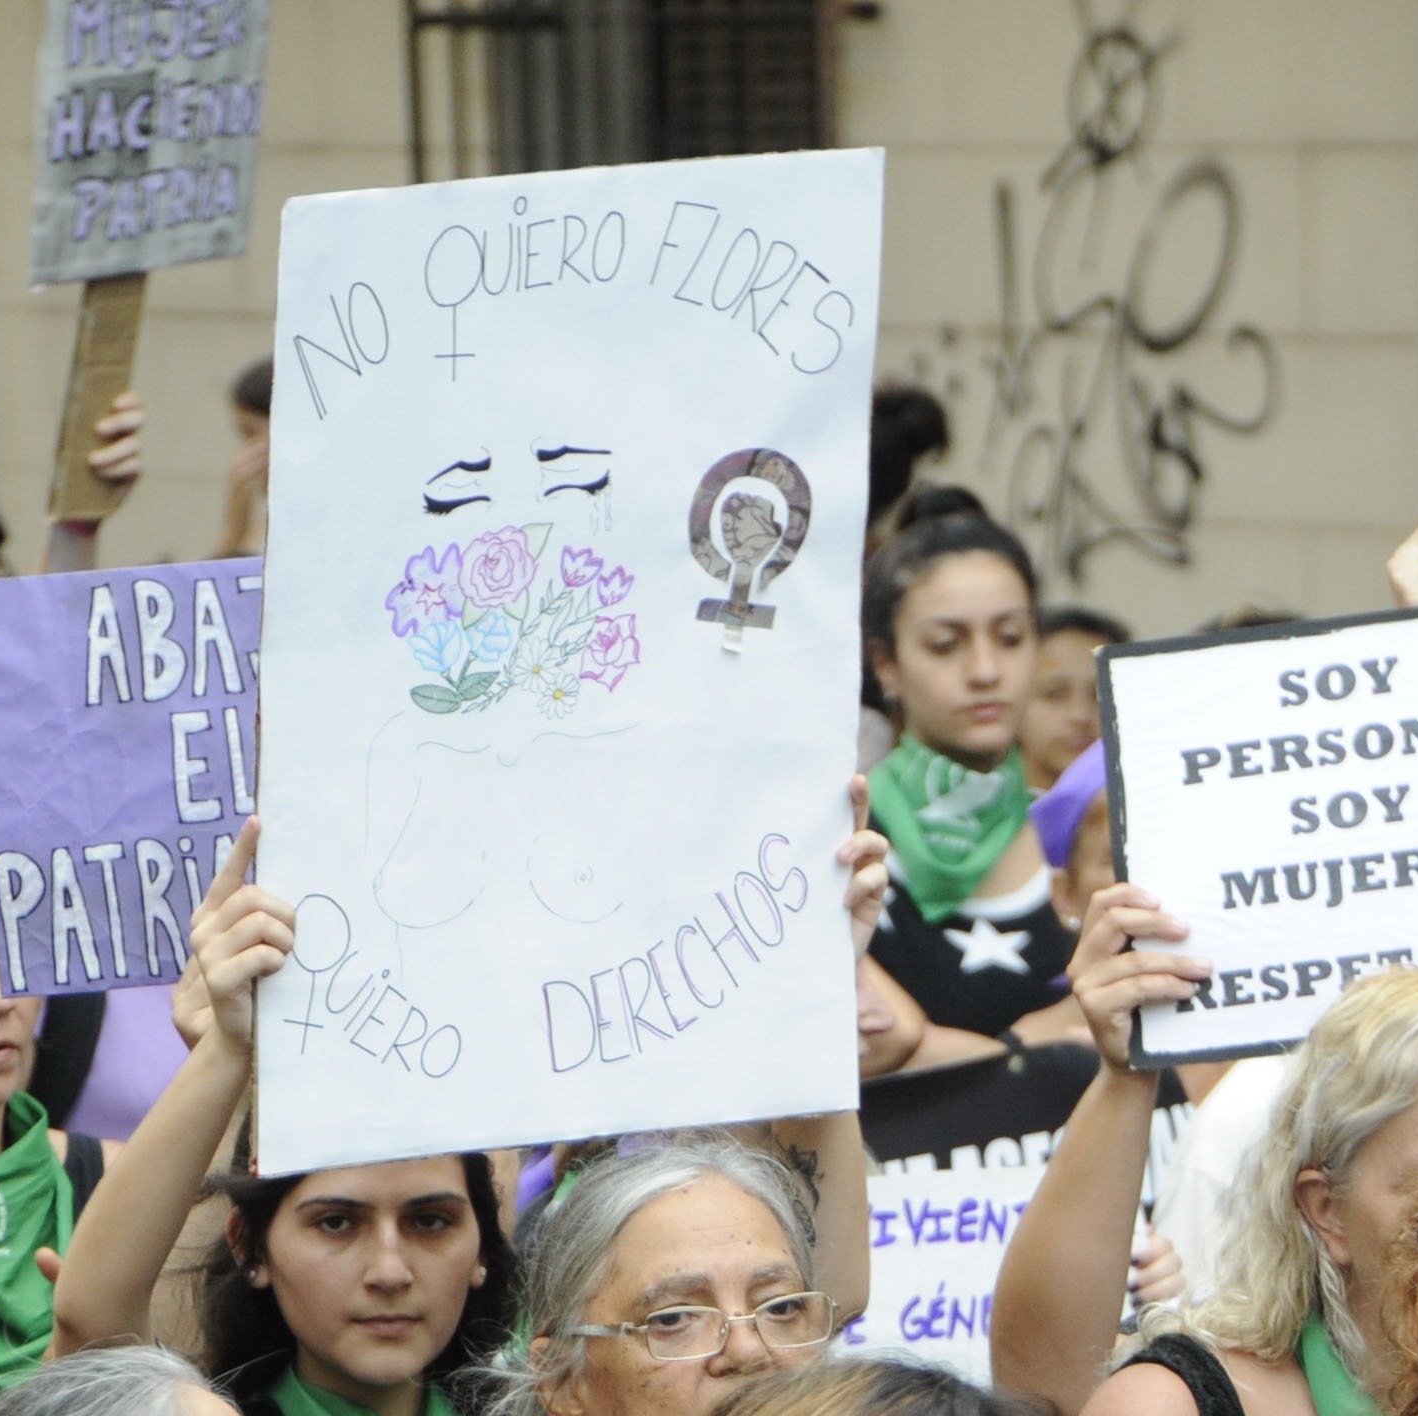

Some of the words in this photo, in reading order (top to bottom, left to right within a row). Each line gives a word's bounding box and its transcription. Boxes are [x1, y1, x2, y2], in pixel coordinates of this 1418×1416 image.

[292, 280, 391, 423] NO
[648, 200, 858, 375] FLORES
[1278, 655, 1400, 709] SOY
[169, 704, 257, 825] EL
[1289, 783, 1412, 836] SOY
[541, 831, 810, 1075] DERECHOS
[867, 1195, 1029, 1250] IVIEN
